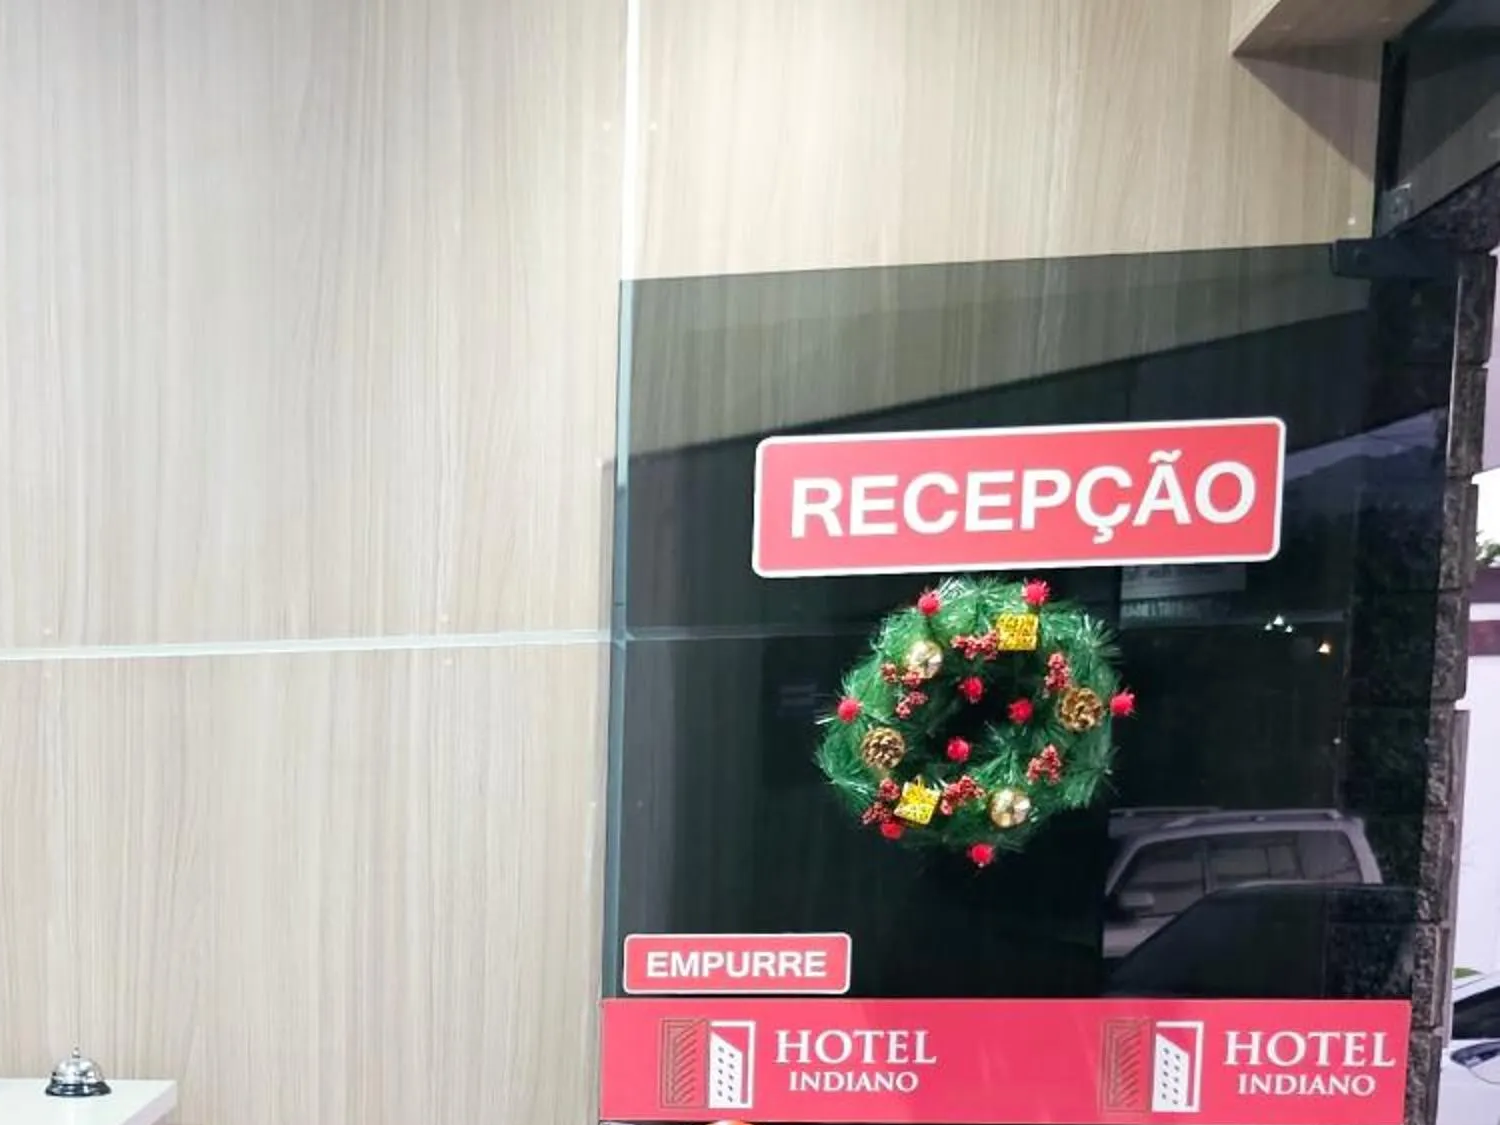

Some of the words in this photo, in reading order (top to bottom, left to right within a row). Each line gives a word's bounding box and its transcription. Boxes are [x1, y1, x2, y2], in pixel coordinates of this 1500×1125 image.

[790, 448, 1257, 545] RECEPÇÃO
[645, 950, 828, 978] EMPURRE
[774, 1029, 938, 1065] HOTEL
[1222, 1030, 1397, 1067] HOTEL
[788, 1071, 919, 1093] INDIANO
[1237, 1073, 1377, 1097] INDIANO
